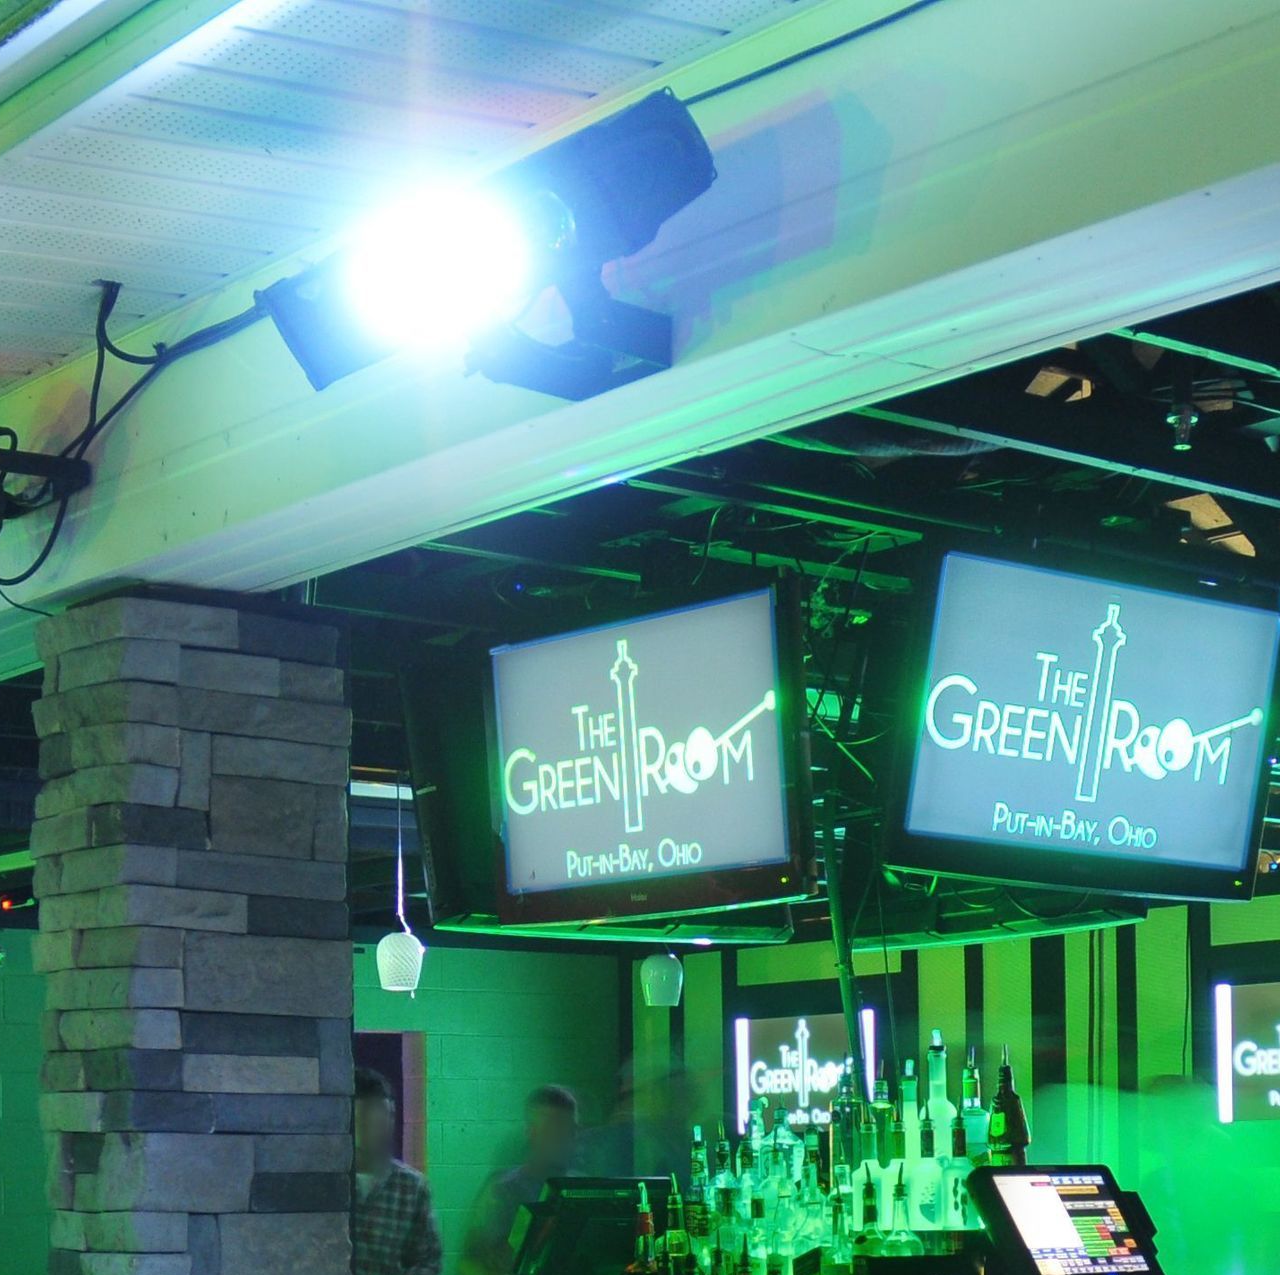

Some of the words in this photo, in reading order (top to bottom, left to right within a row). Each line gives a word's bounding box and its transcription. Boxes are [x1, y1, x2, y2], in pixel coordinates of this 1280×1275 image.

[1036, 652, 1088, 708] THE
[571, 705, 617, 751] THE
[925, 674, 1083, 765] GREEN
[1104, 699, 1233, 786] ROOM
[503, 747, 621, 815] GREEN
[638, 726, 754, 799] ROOM
[657, 837, 702, 868] OHIO
[1107, 815, 1158, 849] OHIO
